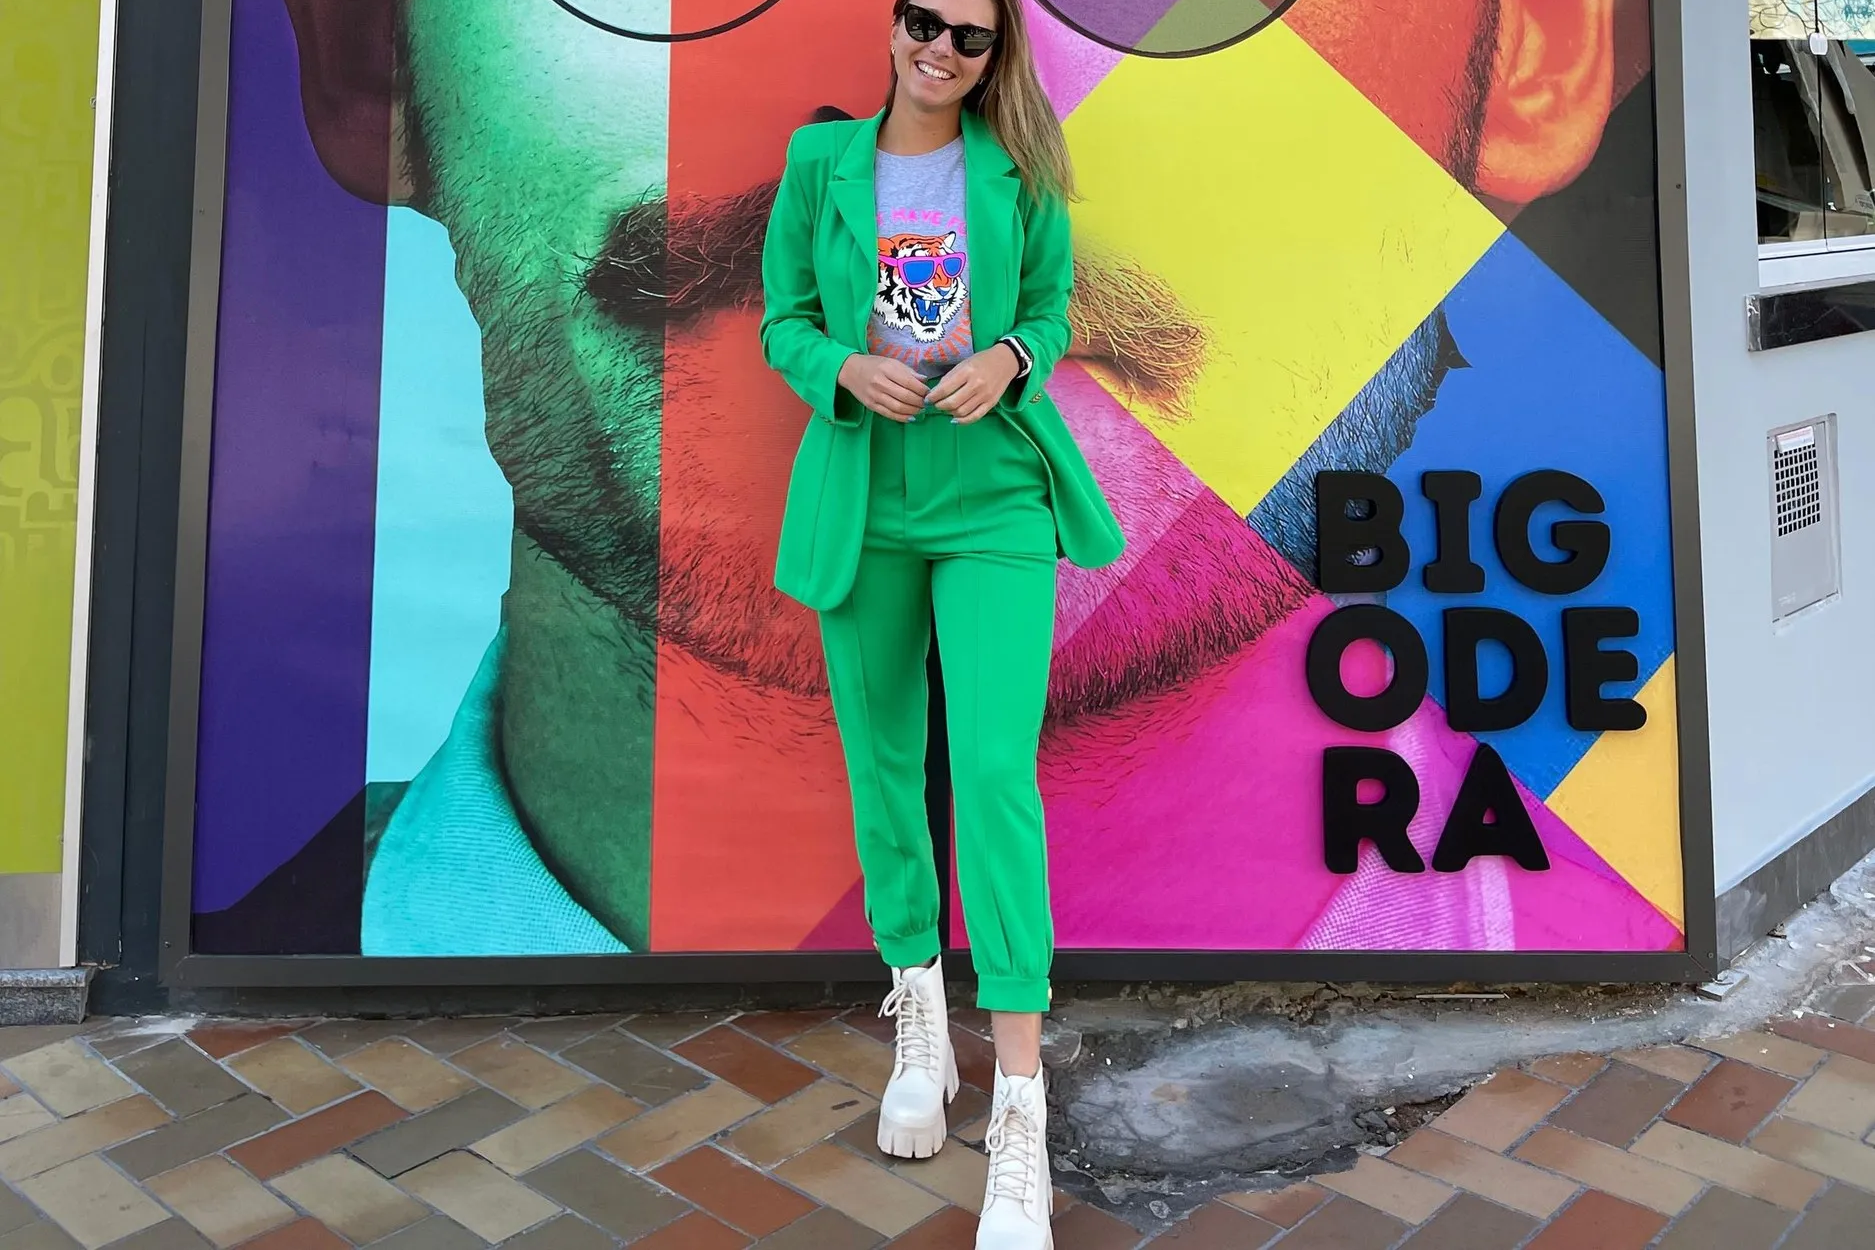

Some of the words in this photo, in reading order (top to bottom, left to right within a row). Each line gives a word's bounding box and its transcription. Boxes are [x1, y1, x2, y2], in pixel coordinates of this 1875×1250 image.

[1317, 469, 1611, 594] BIG
[1306, 604, 1648, 732] ODE
[1323, 742, 1551, 874] RA
